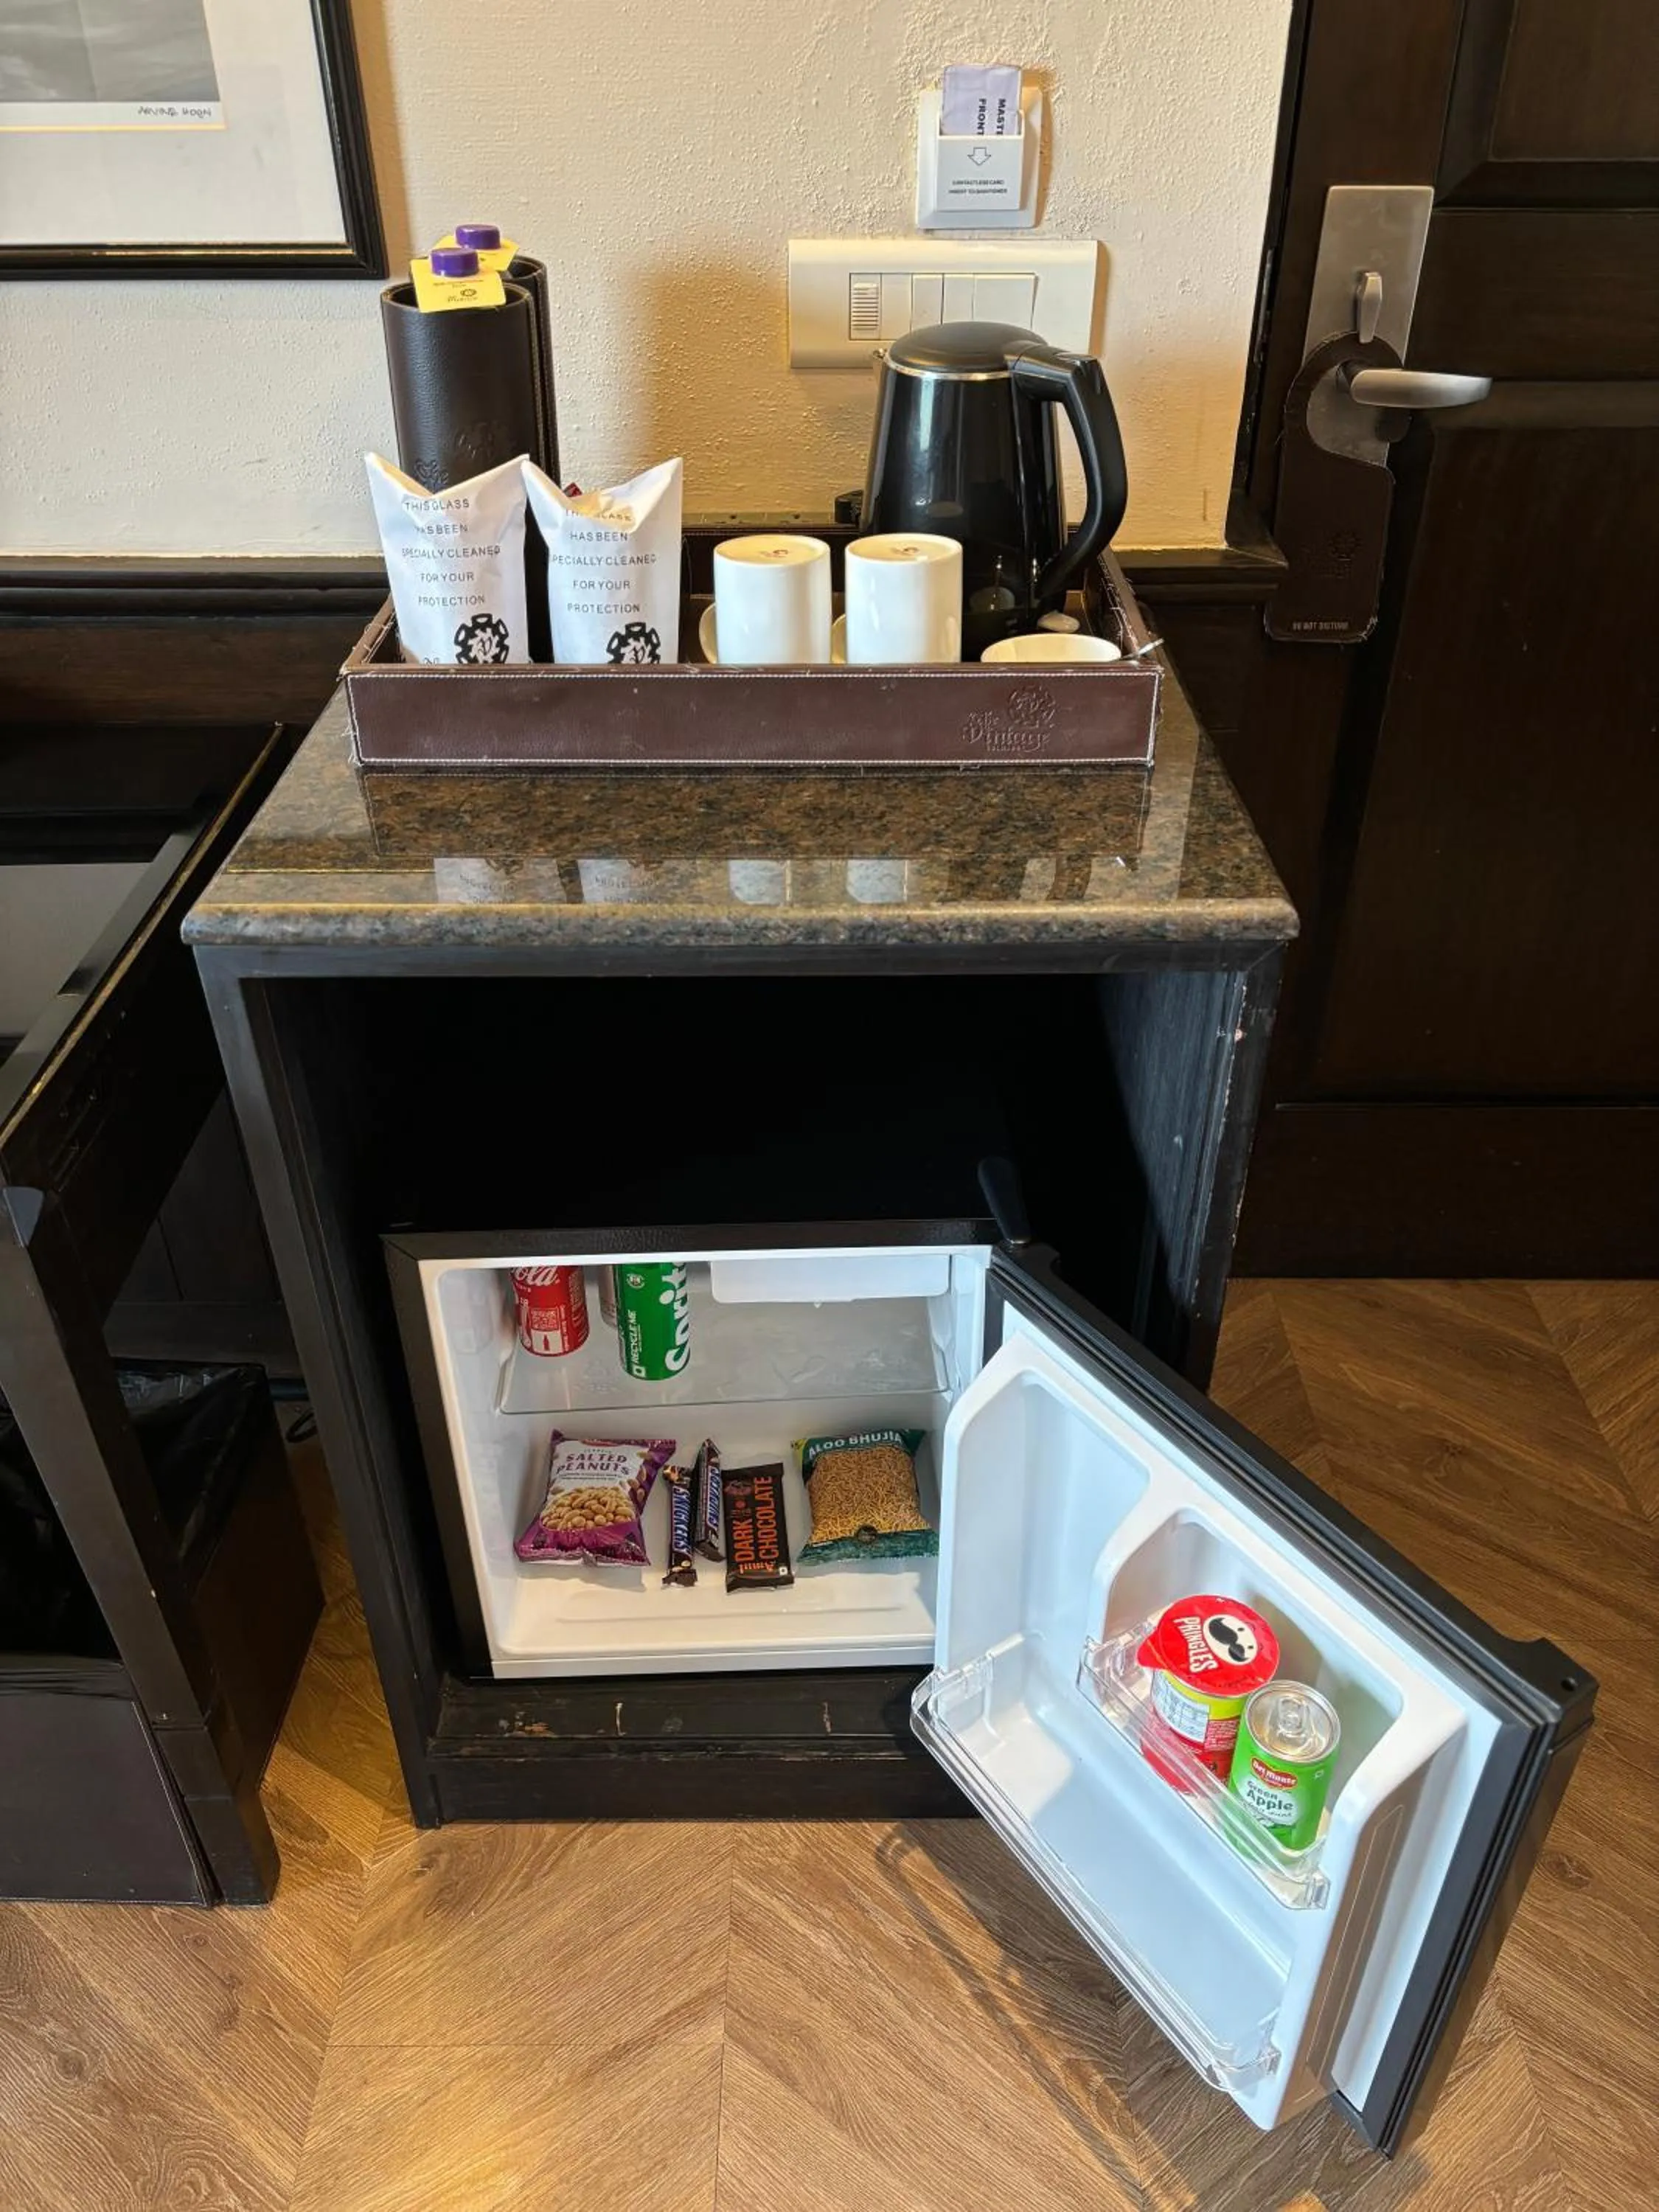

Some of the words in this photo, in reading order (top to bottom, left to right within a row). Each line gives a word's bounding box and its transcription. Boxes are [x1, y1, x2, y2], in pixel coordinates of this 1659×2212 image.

[406, 501, 429, 511] THIS
[436, 523, 468, 535] BEEN
[569, 532, 593, 541] HAS
[595, 531, 628, 541] BEEN
[442, 571, 474, 582] YOUR
[573, 580, 595, 590] FOR
[598, 580, 630, 591] YOUR
[418, 595, 485, 606] PROTECTION
[567, 602, 641, 614] PROTECTION
[627, 1310, 637, 1325] ME
[659, 1262, 691, 1371] Sprit
[629, 1325, 640, 1363] RECYCLE
[809, 1439, 846, 1459] ALOO
[848, 1430, 903, 1445] BHUJIA
[566, 1453, 627, 1464] SALTED
[556, 1461, 630, 1475] PEANUTS
[754, 1475, 779, 1559] CHOCOLATE
[733, 1517, 756, 1562] DARK
[1173, 1616, 1219, 1674] PRINGLES
[1247, 1781, 1278, 1800] Green
[1247, 1790, 1294, 1810] Apple
